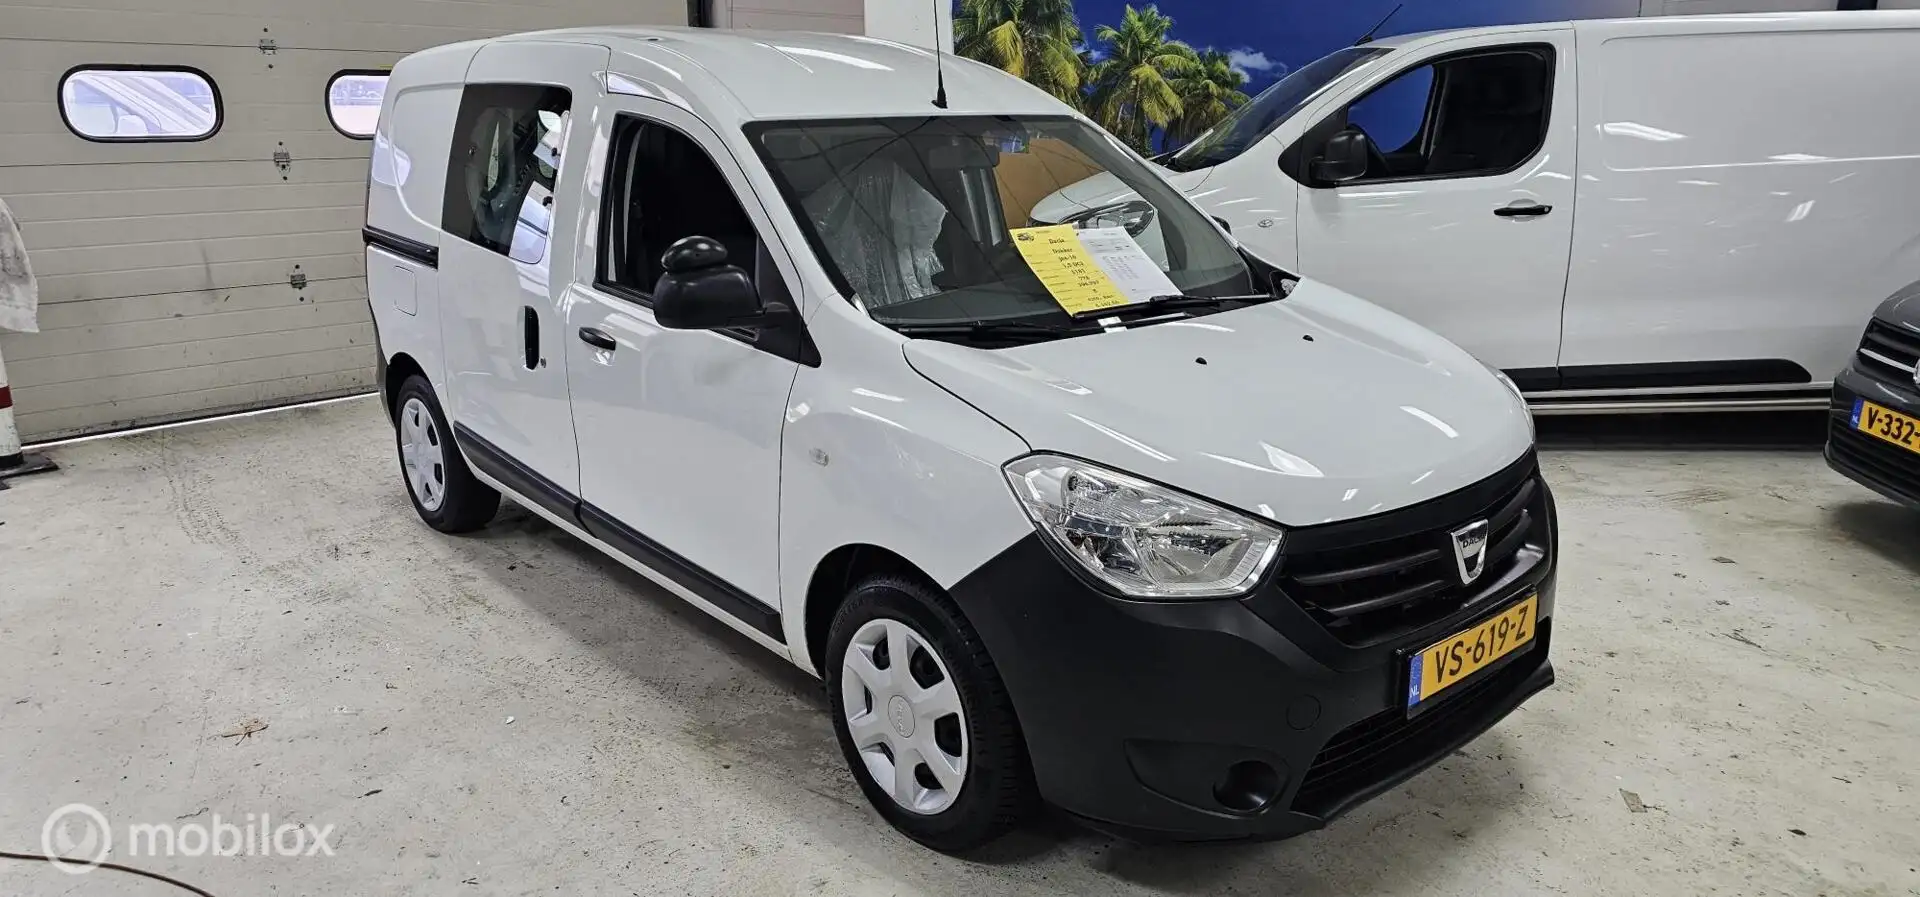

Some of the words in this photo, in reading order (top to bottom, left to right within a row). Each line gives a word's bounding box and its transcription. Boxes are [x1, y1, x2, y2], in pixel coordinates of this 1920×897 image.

[1867, 406, 1920, 446] V-332-
[1409, 684, 1420, 699] NL
[1435, 604, 1529, 684] VS-619-Z
